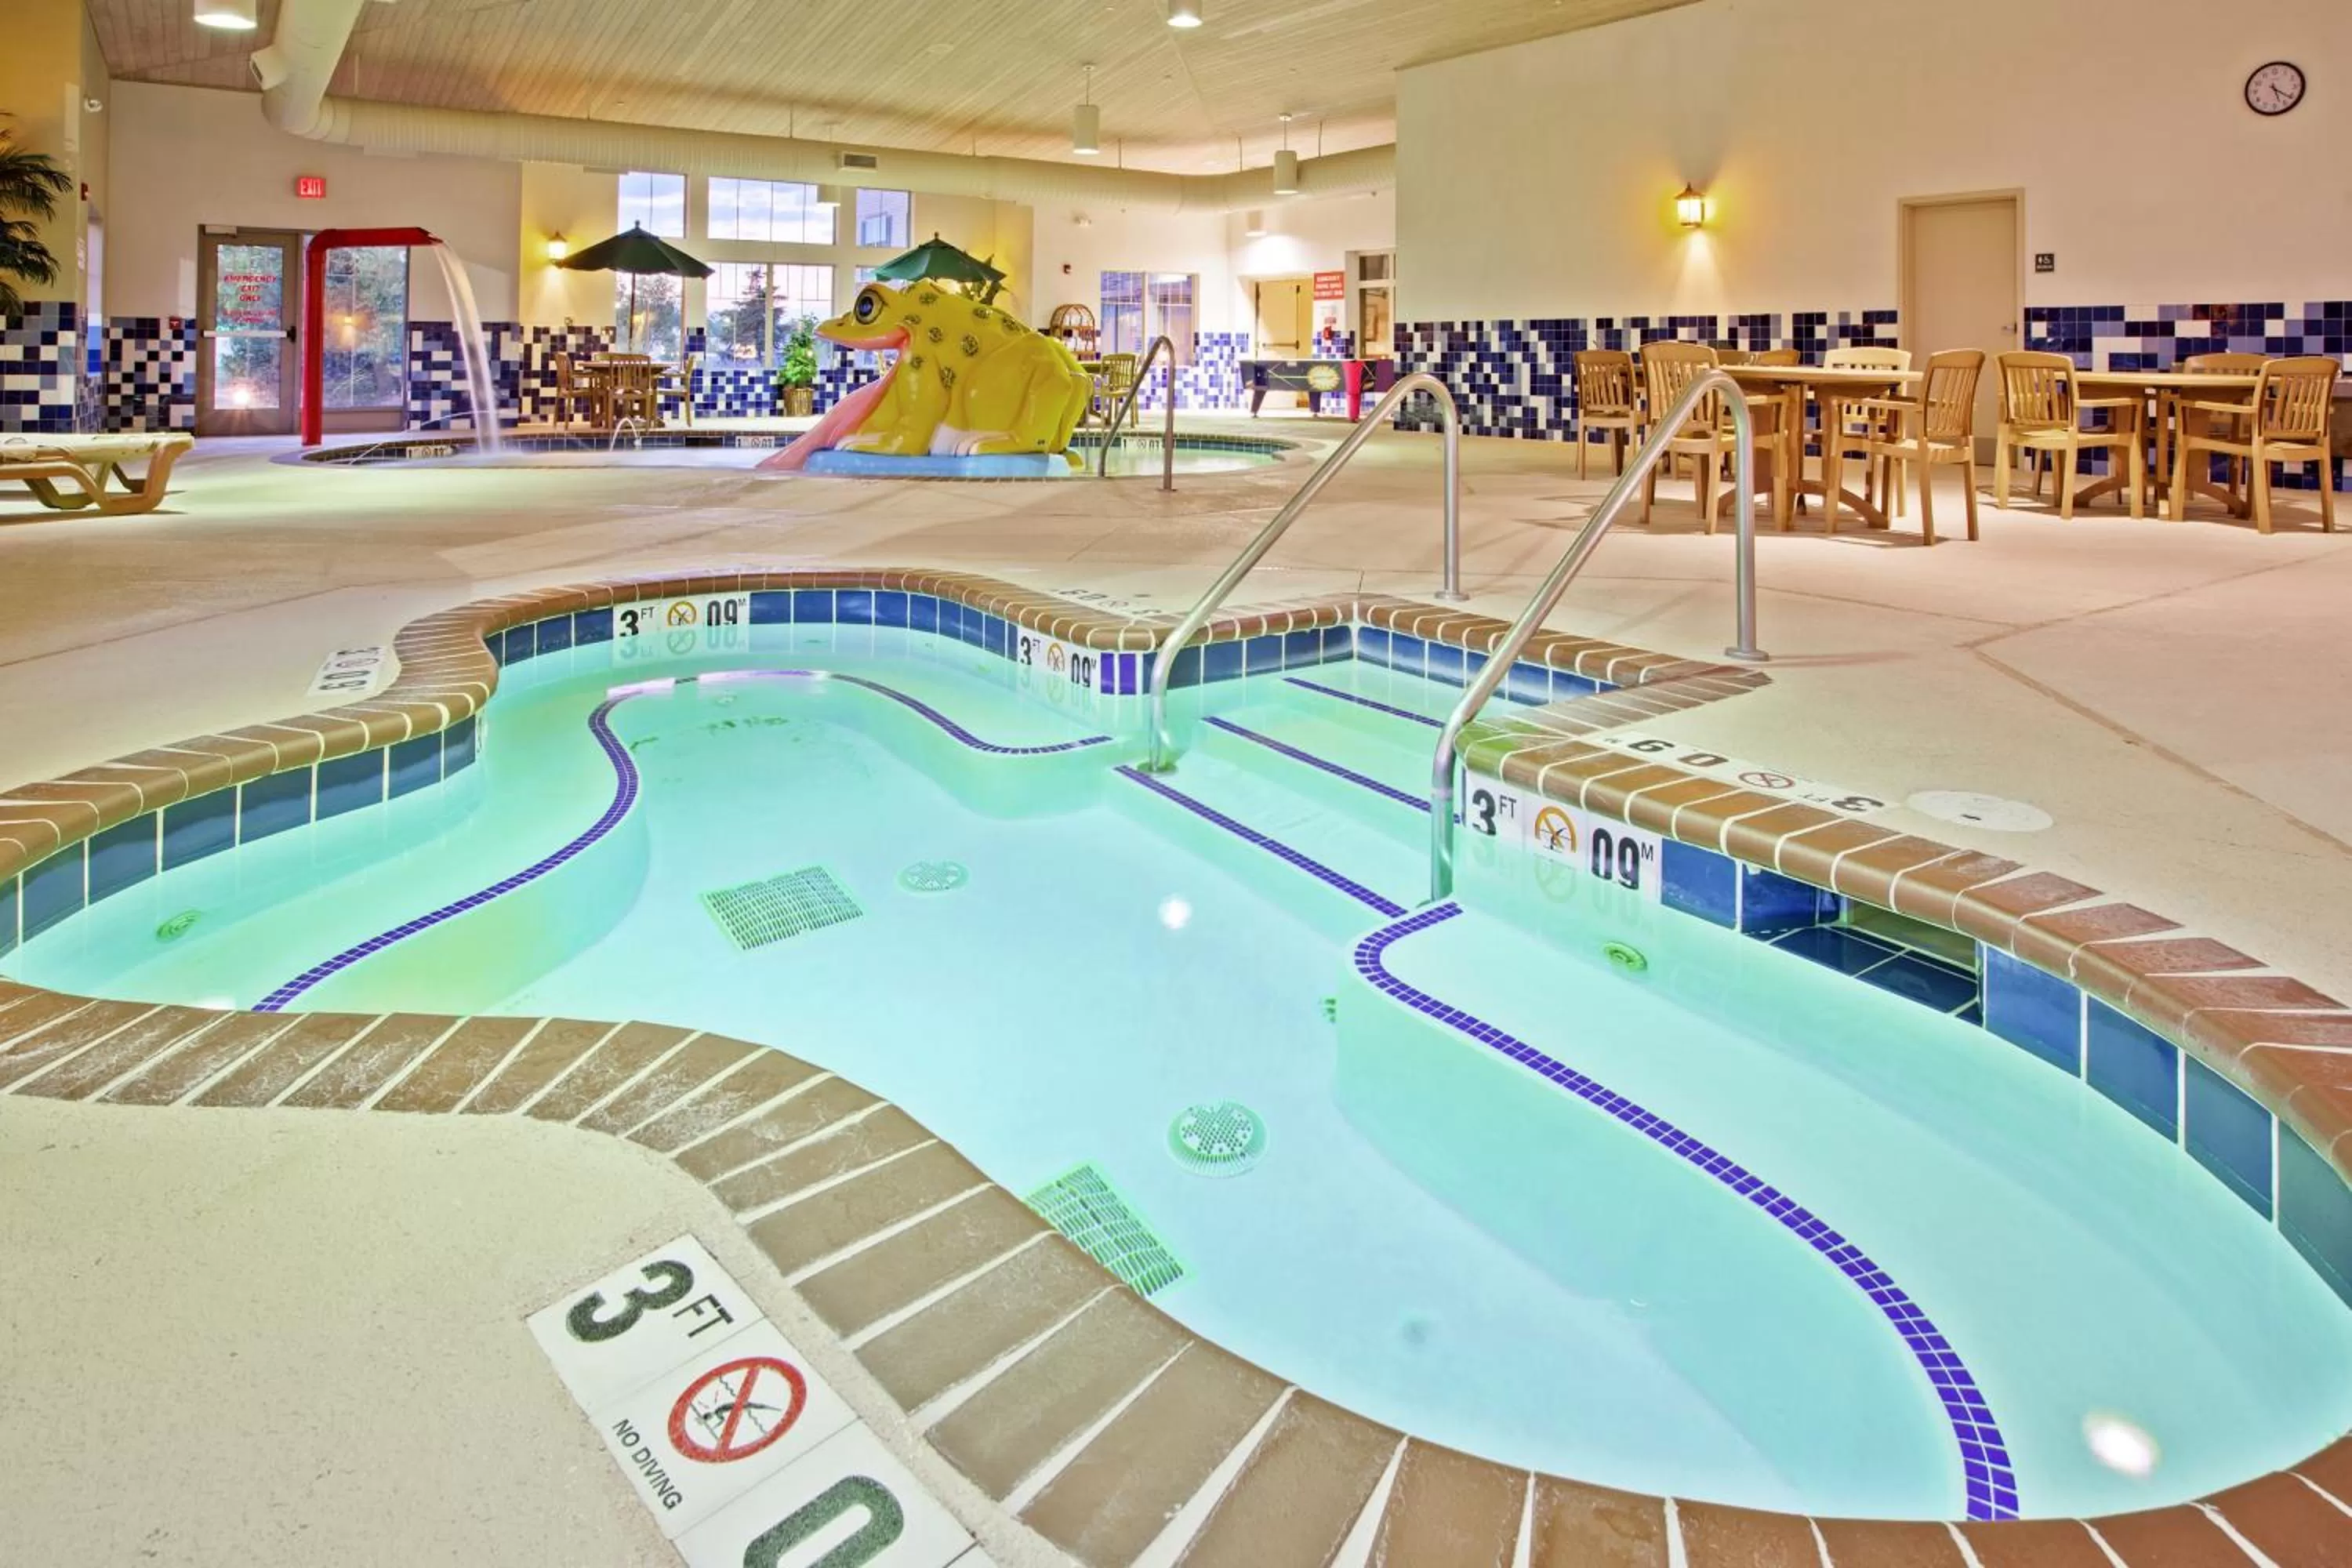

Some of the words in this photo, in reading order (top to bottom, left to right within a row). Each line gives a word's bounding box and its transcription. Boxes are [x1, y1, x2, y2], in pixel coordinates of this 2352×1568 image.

[300, 178, 322, 195] EXIT
[565, 1260, 695, 1343] 3
[672, 1294, 735, 1338] FT
[612, 1417, 641, 1449] NO
[632, 1447, 684, 1512] DIVING
